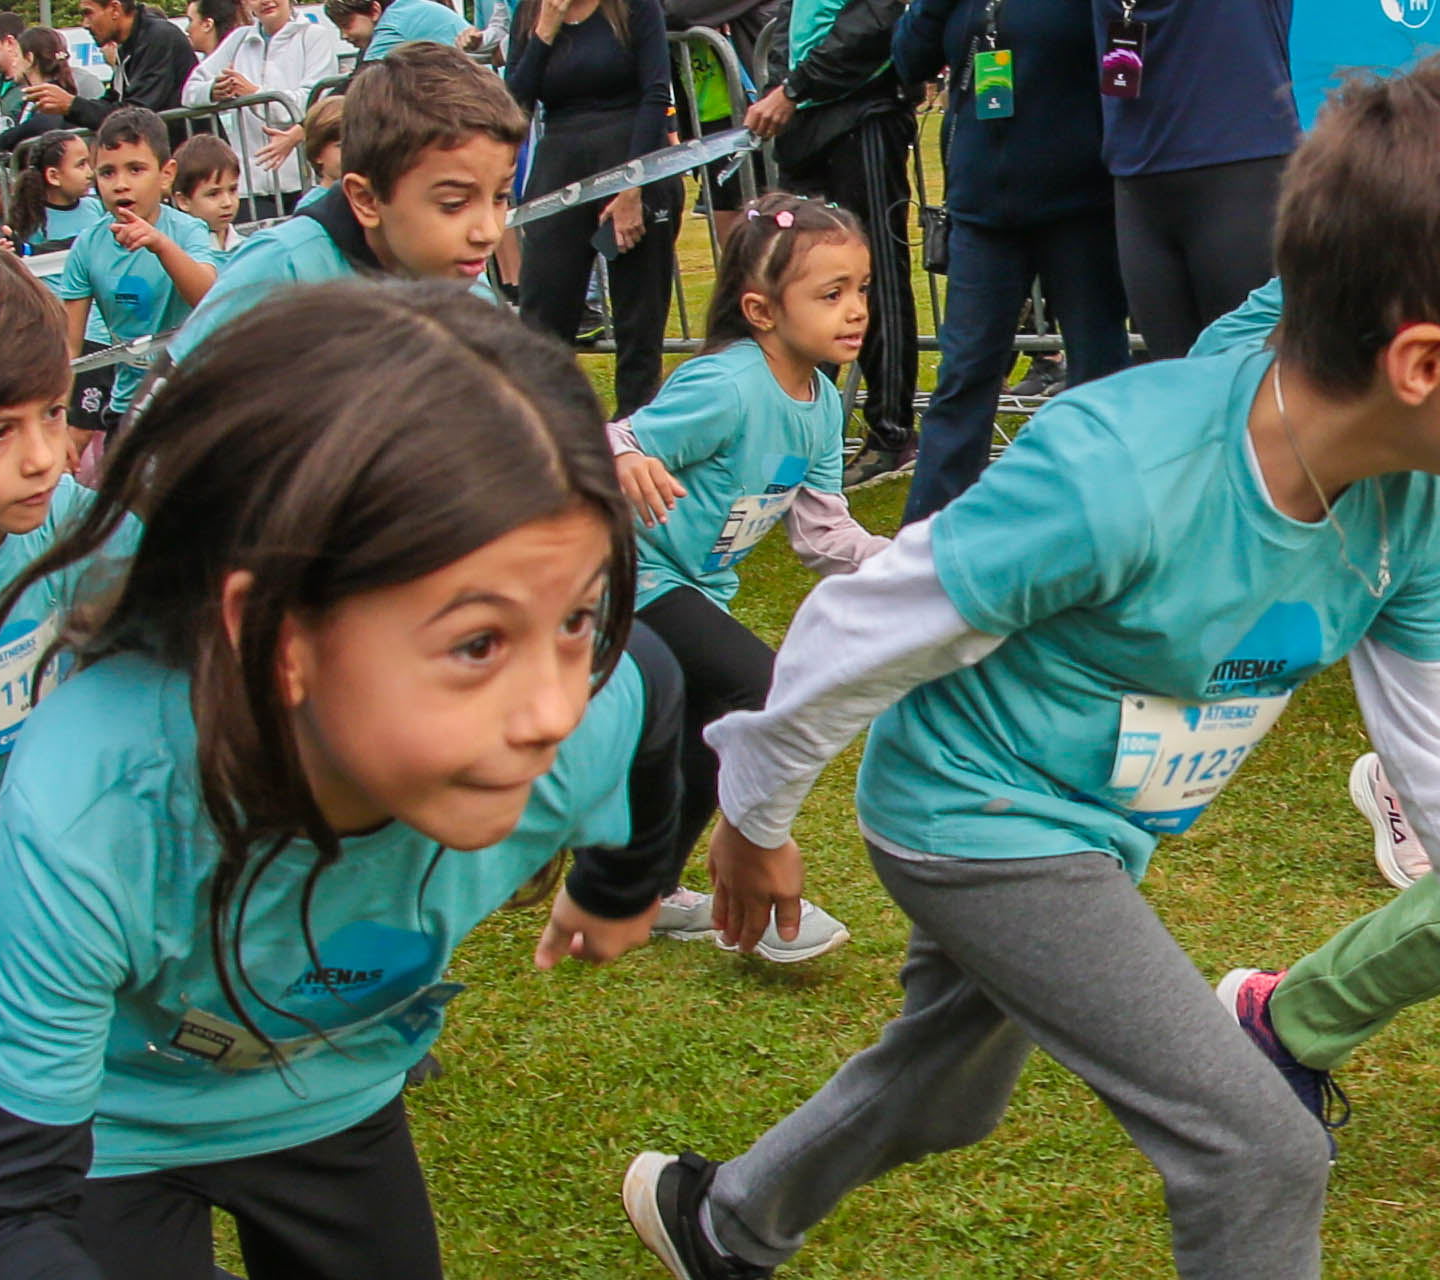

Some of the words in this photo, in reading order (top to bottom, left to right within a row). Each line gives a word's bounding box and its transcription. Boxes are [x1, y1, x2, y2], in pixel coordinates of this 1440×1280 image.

[1208, 658, 1288, 682] ATHENAS
[1203, 703, 1260, 721] ATHENAS
[1162, 741, 1252, 787] 1123
[1383, 795, 1407, 845] FILA
